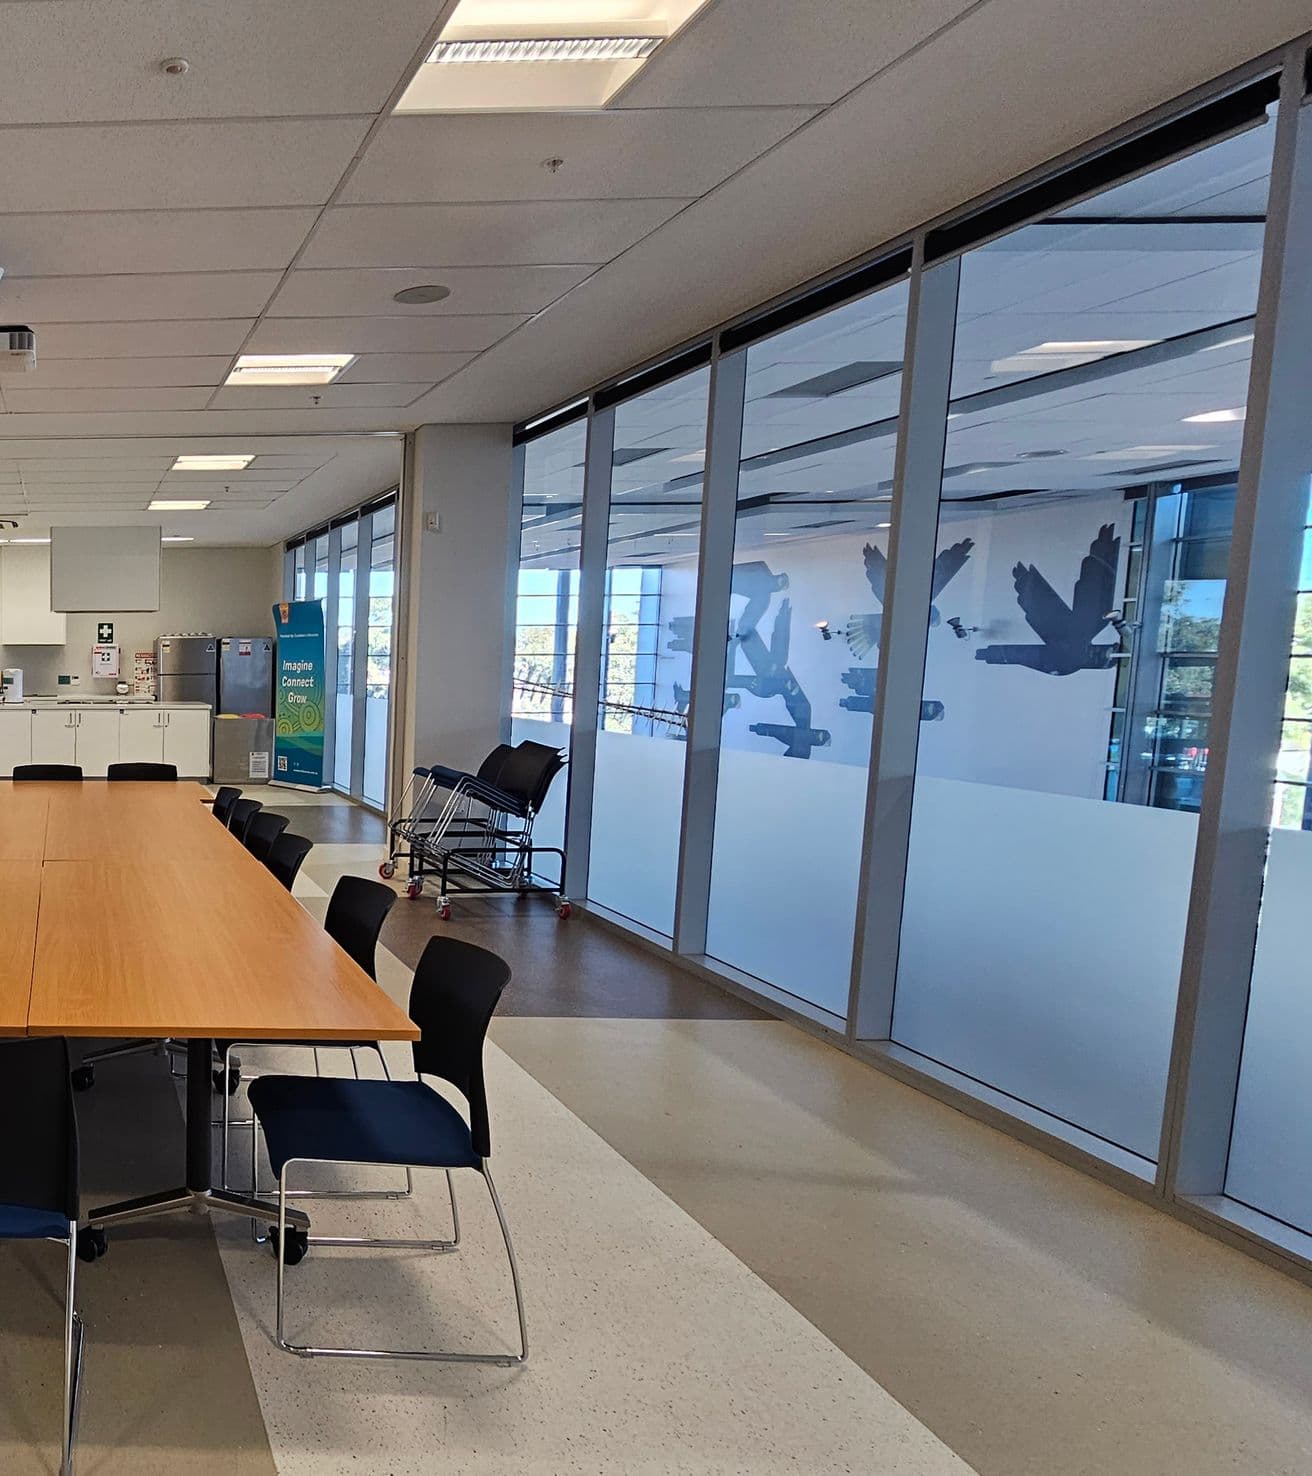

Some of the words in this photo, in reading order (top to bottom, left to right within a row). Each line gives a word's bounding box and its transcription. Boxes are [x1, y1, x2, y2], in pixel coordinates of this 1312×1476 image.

[282, 660, 313, 674] Imagine
[281, 676, 314, 687] Connect
[288, 692, 307, 703] Grow
